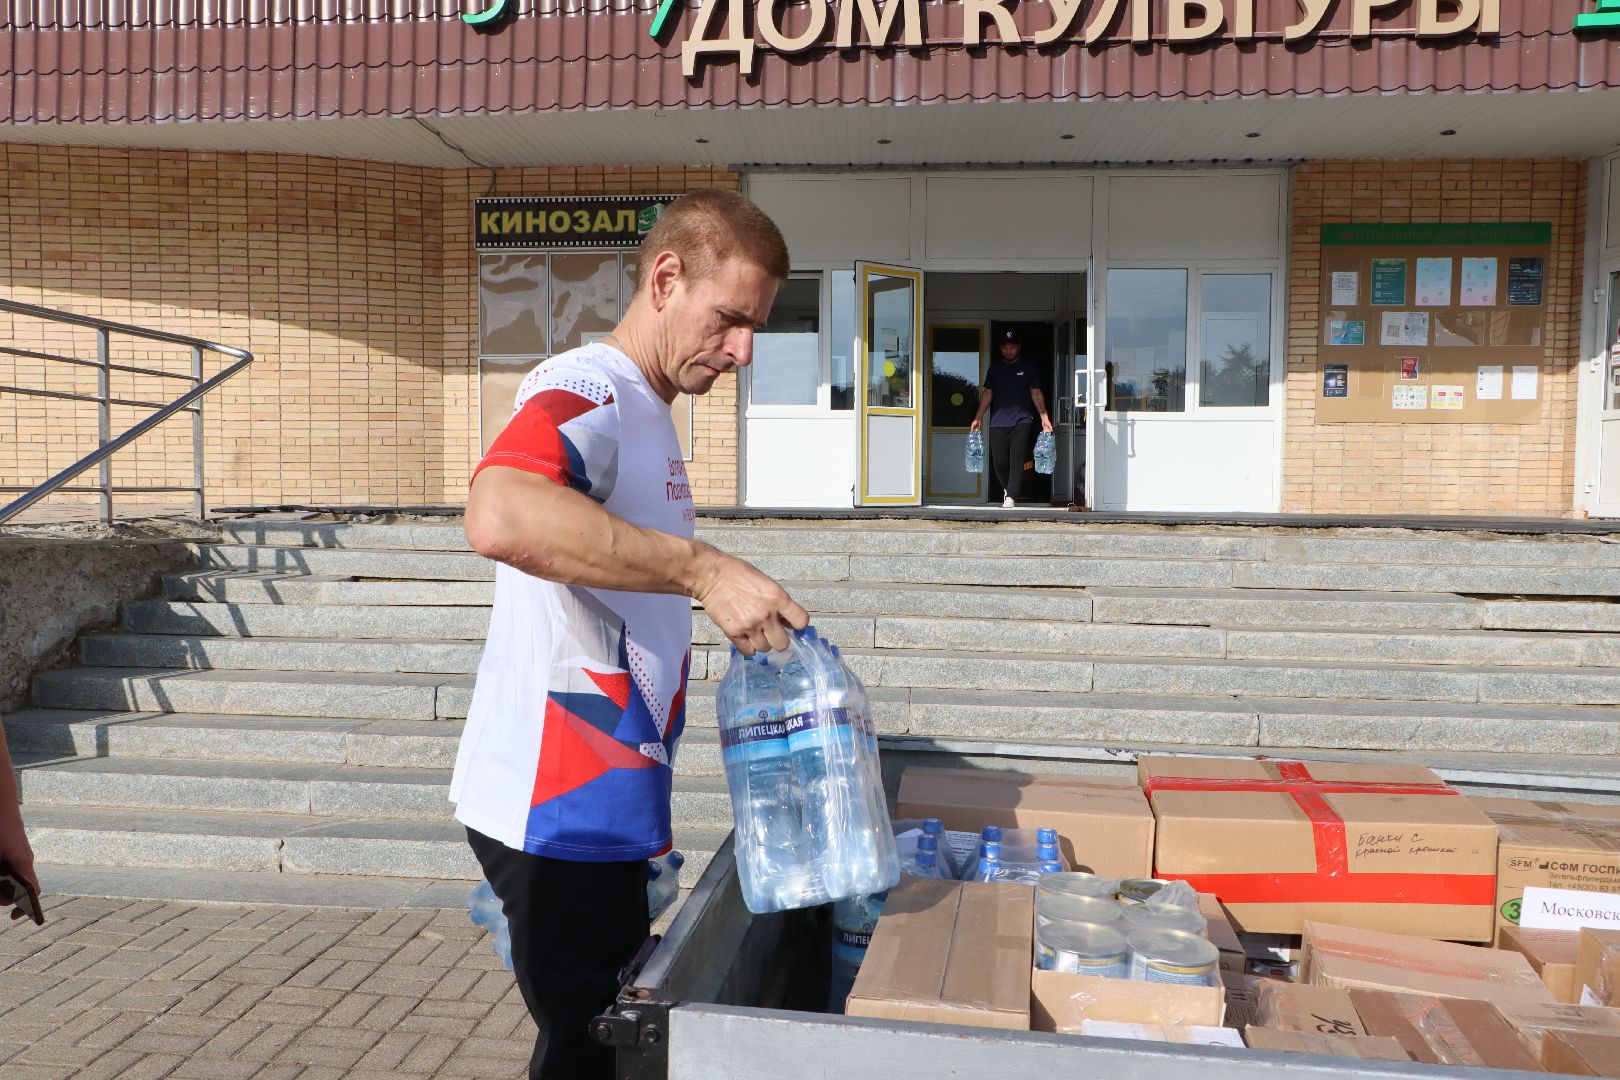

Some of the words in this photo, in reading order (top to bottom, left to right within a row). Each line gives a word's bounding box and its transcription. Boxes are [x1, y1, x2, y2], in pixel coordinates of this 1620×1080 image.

[480, 209, 636, 234] КИНОЗАЛ
[1510, 859, 1533, 868] SFM
[1550, 861, 1579, 873] СФМ
